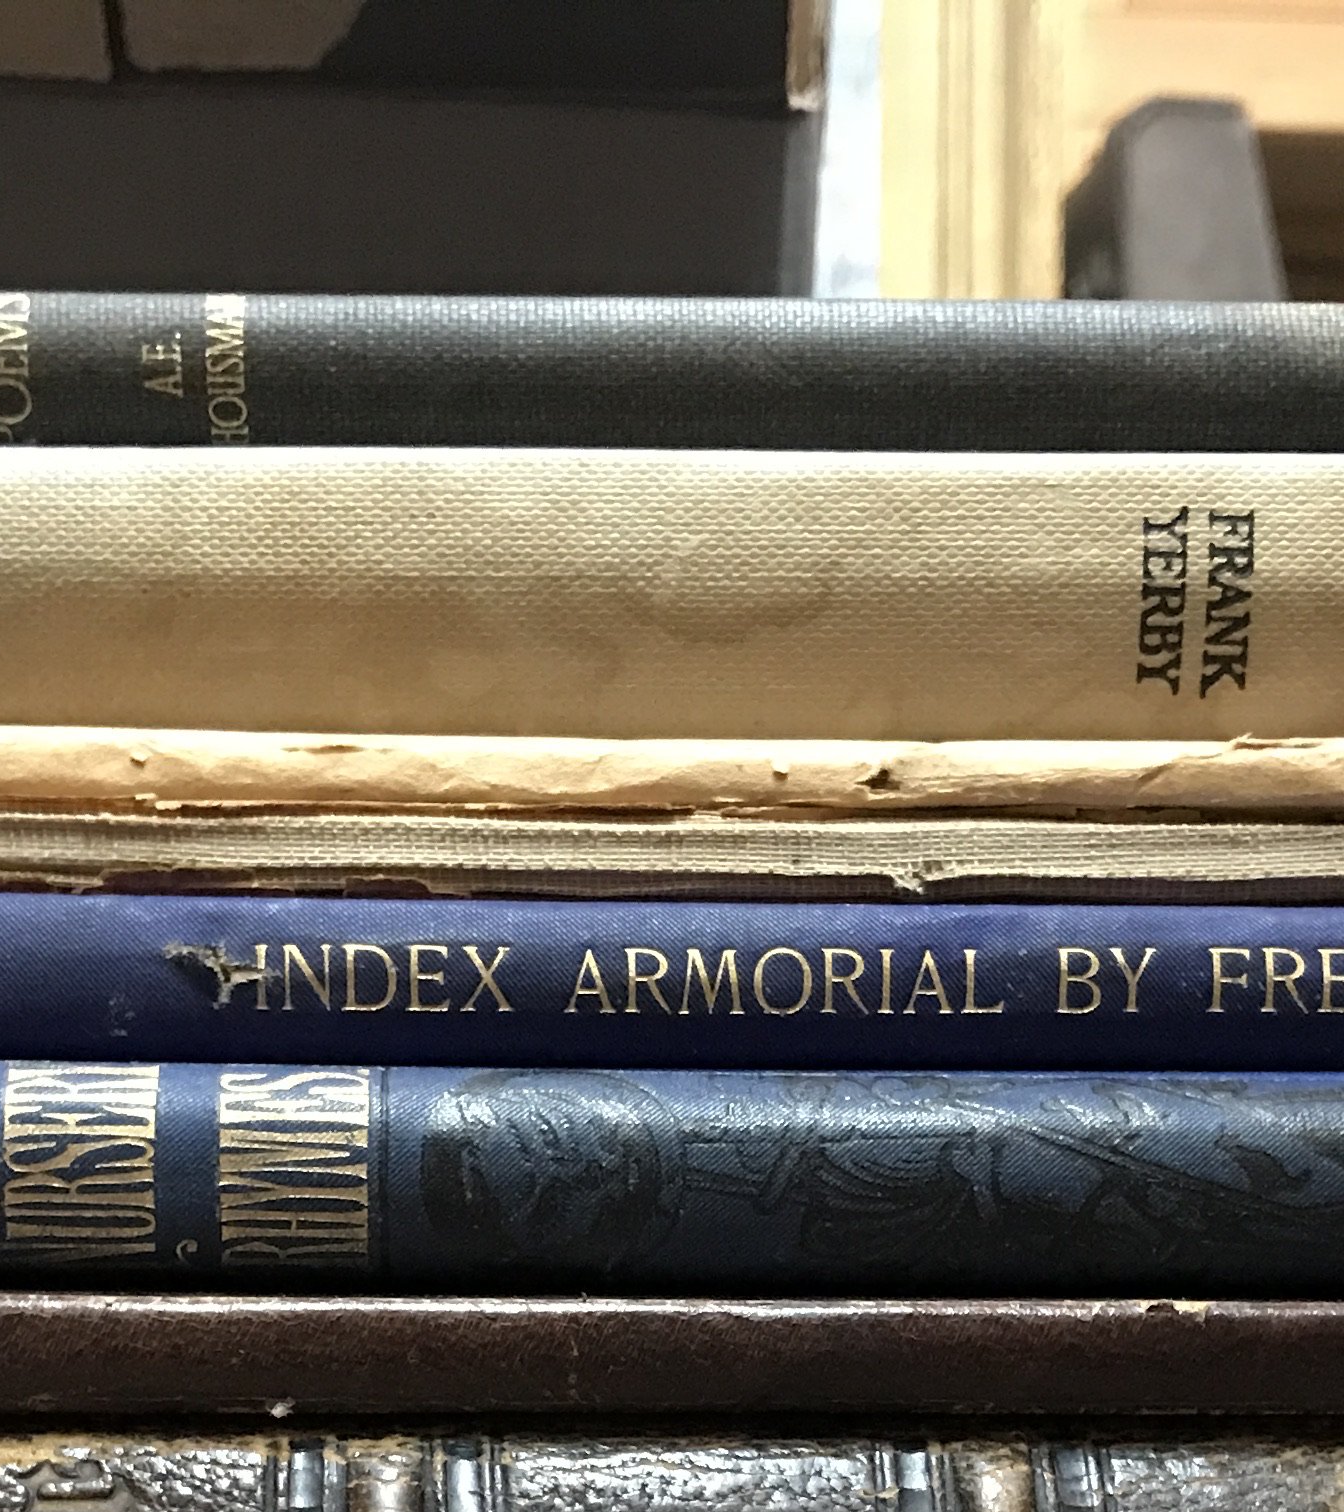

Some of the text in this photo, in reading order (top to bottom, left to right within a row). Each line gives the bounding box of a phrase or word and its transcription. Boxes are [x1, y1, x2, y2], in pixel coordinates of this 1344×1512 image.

[1136, 505, 1190, 696] YERBY
[1199, 507, 1256, 699] FRANK
[253, 944, 515, 1013] INDEX
[564, 946, 1006, 1017] ARMORIAL
[1056, 946, 1157, 1015] BY
